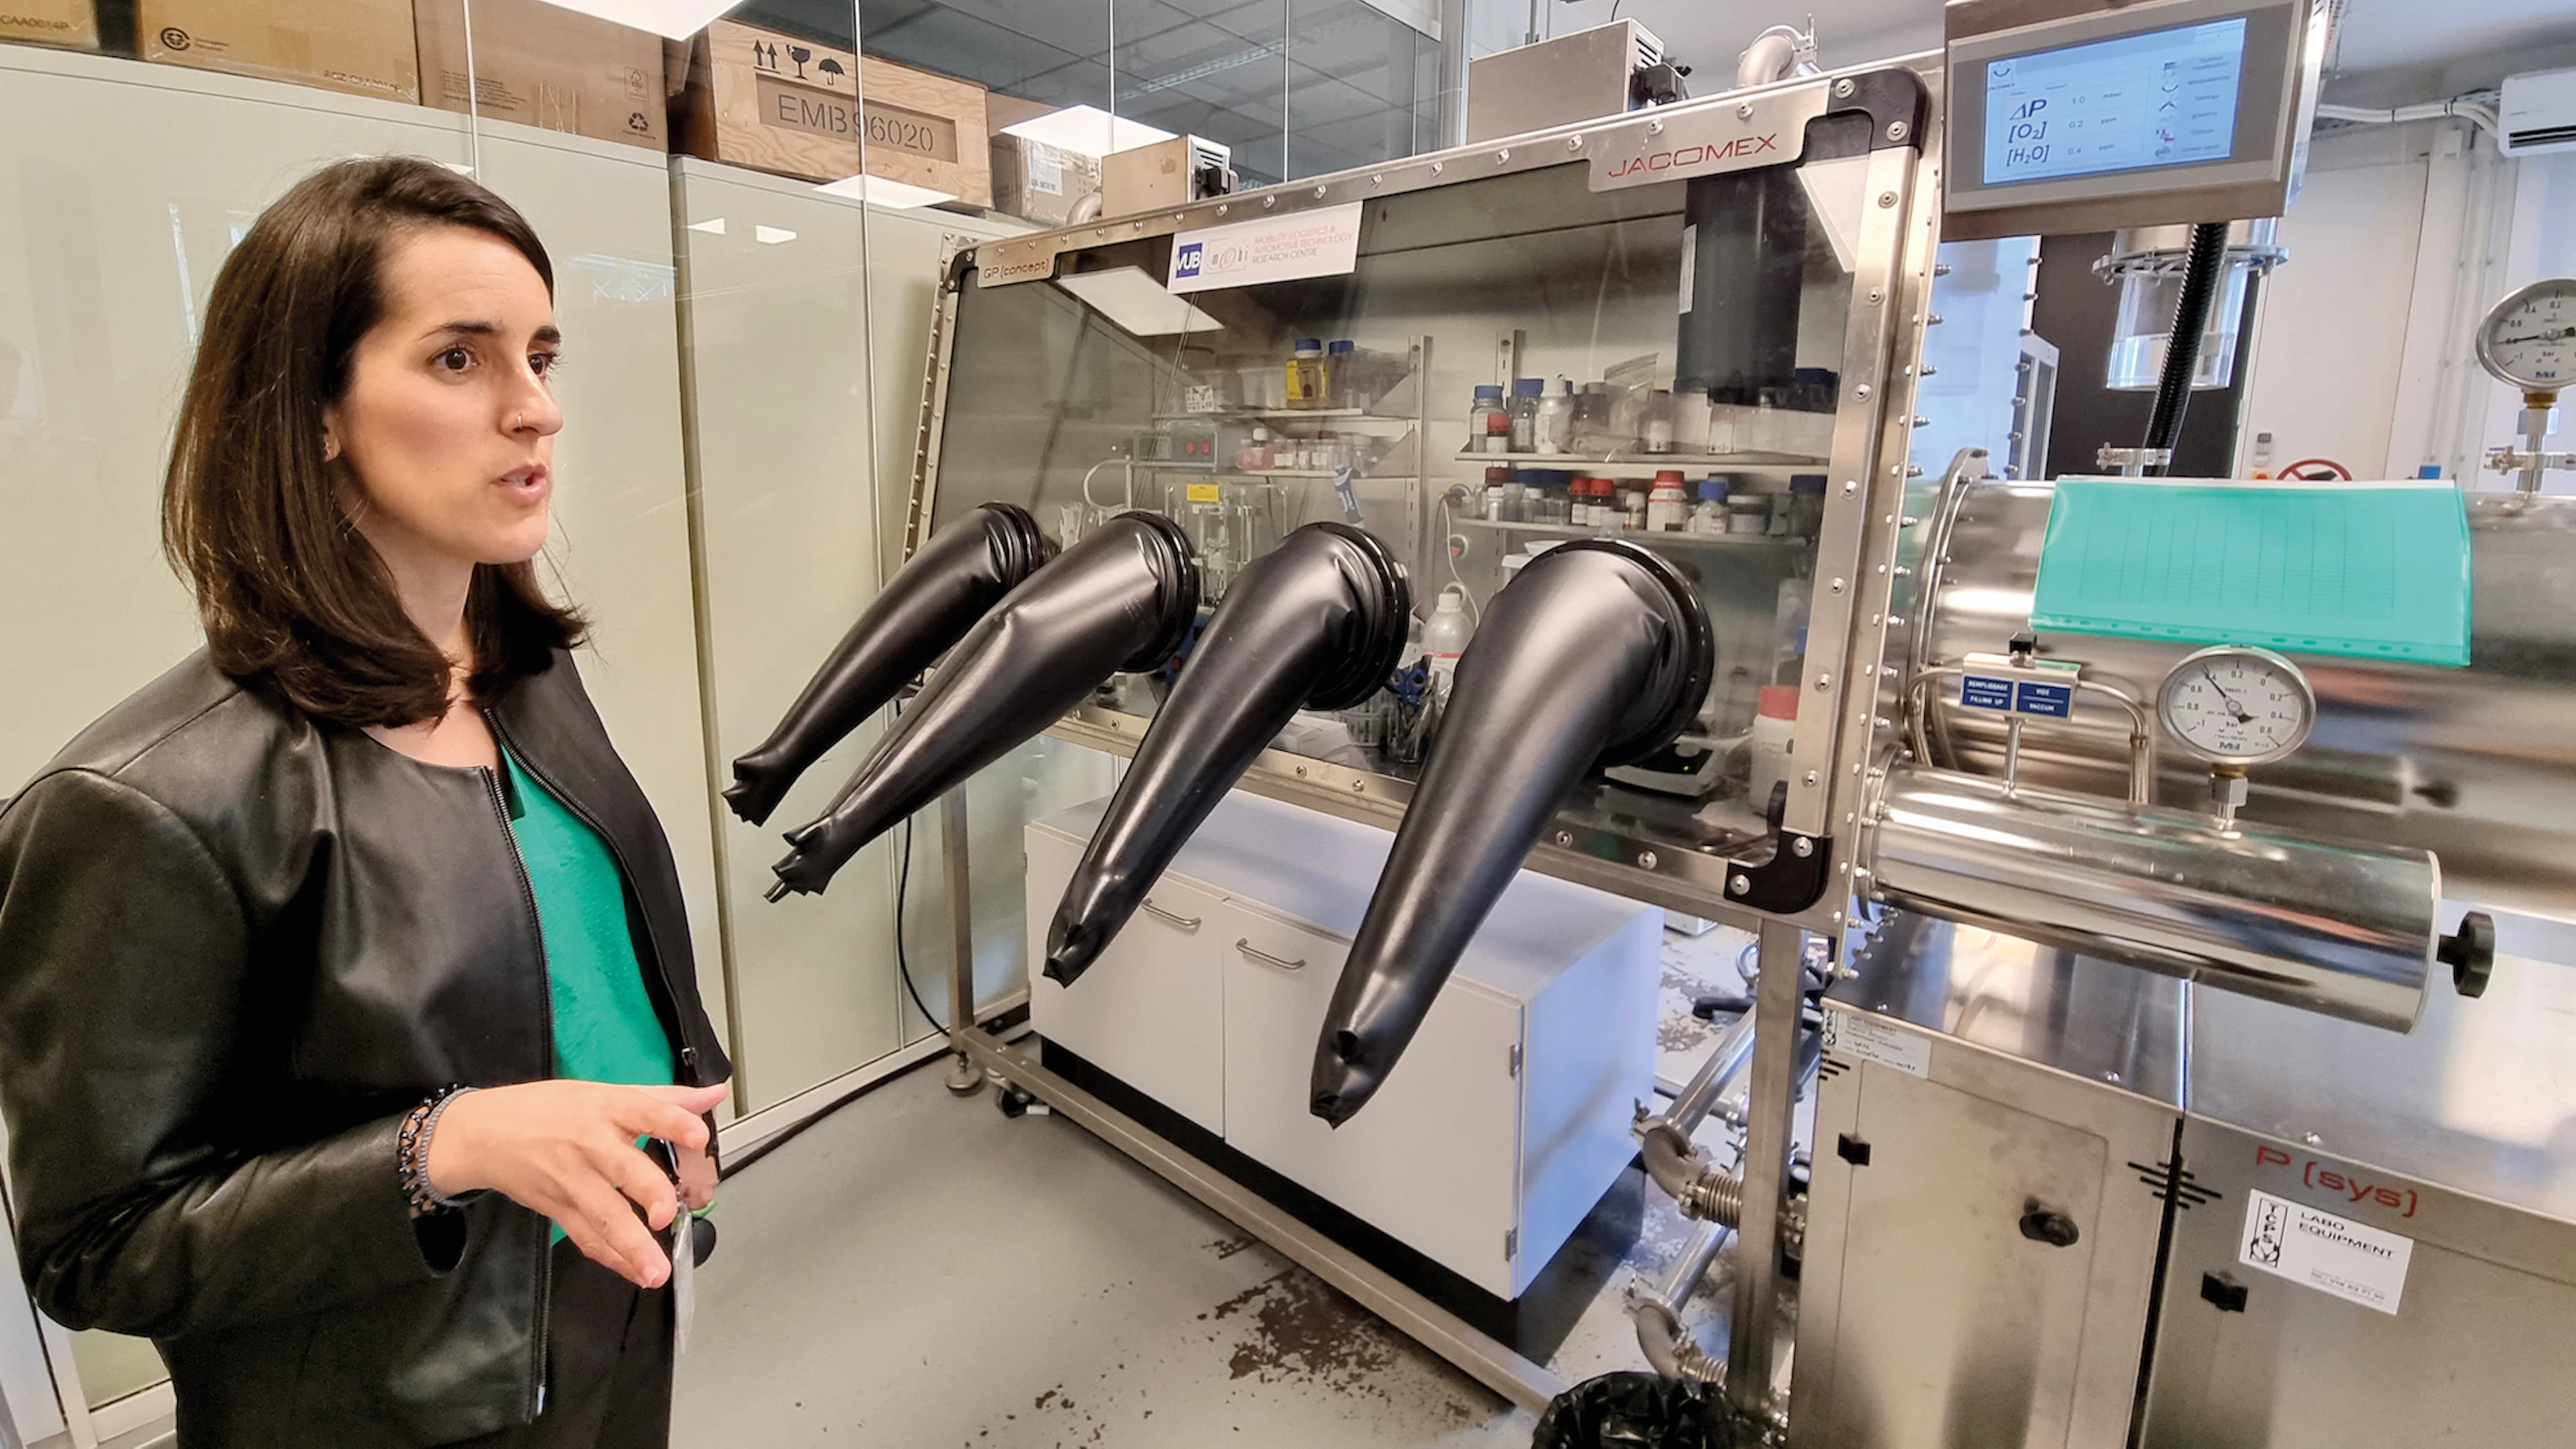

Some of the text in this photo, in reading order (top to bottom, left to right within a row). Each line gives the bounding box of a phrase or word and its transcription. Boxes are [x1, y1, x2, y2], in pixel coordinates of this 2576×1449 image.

[778, 93, 848, 133] EMB
[2069, 120, 2084, 129] 0.2
[1609, 133, 1777, 178] JACOMEX
[1252, 248, 1318, 264] RESEARCH CENTRE
[2231, 670, 2244, 680] 0.2
[2260, 678, 2266, 686] 0
[1994, 698, 2004, 706] UP
[2270, 693, 2282, 702] 0.2
[2186, 703, 2199, 711] 0.8
[2271, 711, 2283, 720] 0.4
[2226, 720, 2239, 728] bar
[2256, 1146, 2292, 1166] P
[2301, 1211, 2345, 1232] LABO
[2298, 1222, 2396, 1259] EQUIPMENT
